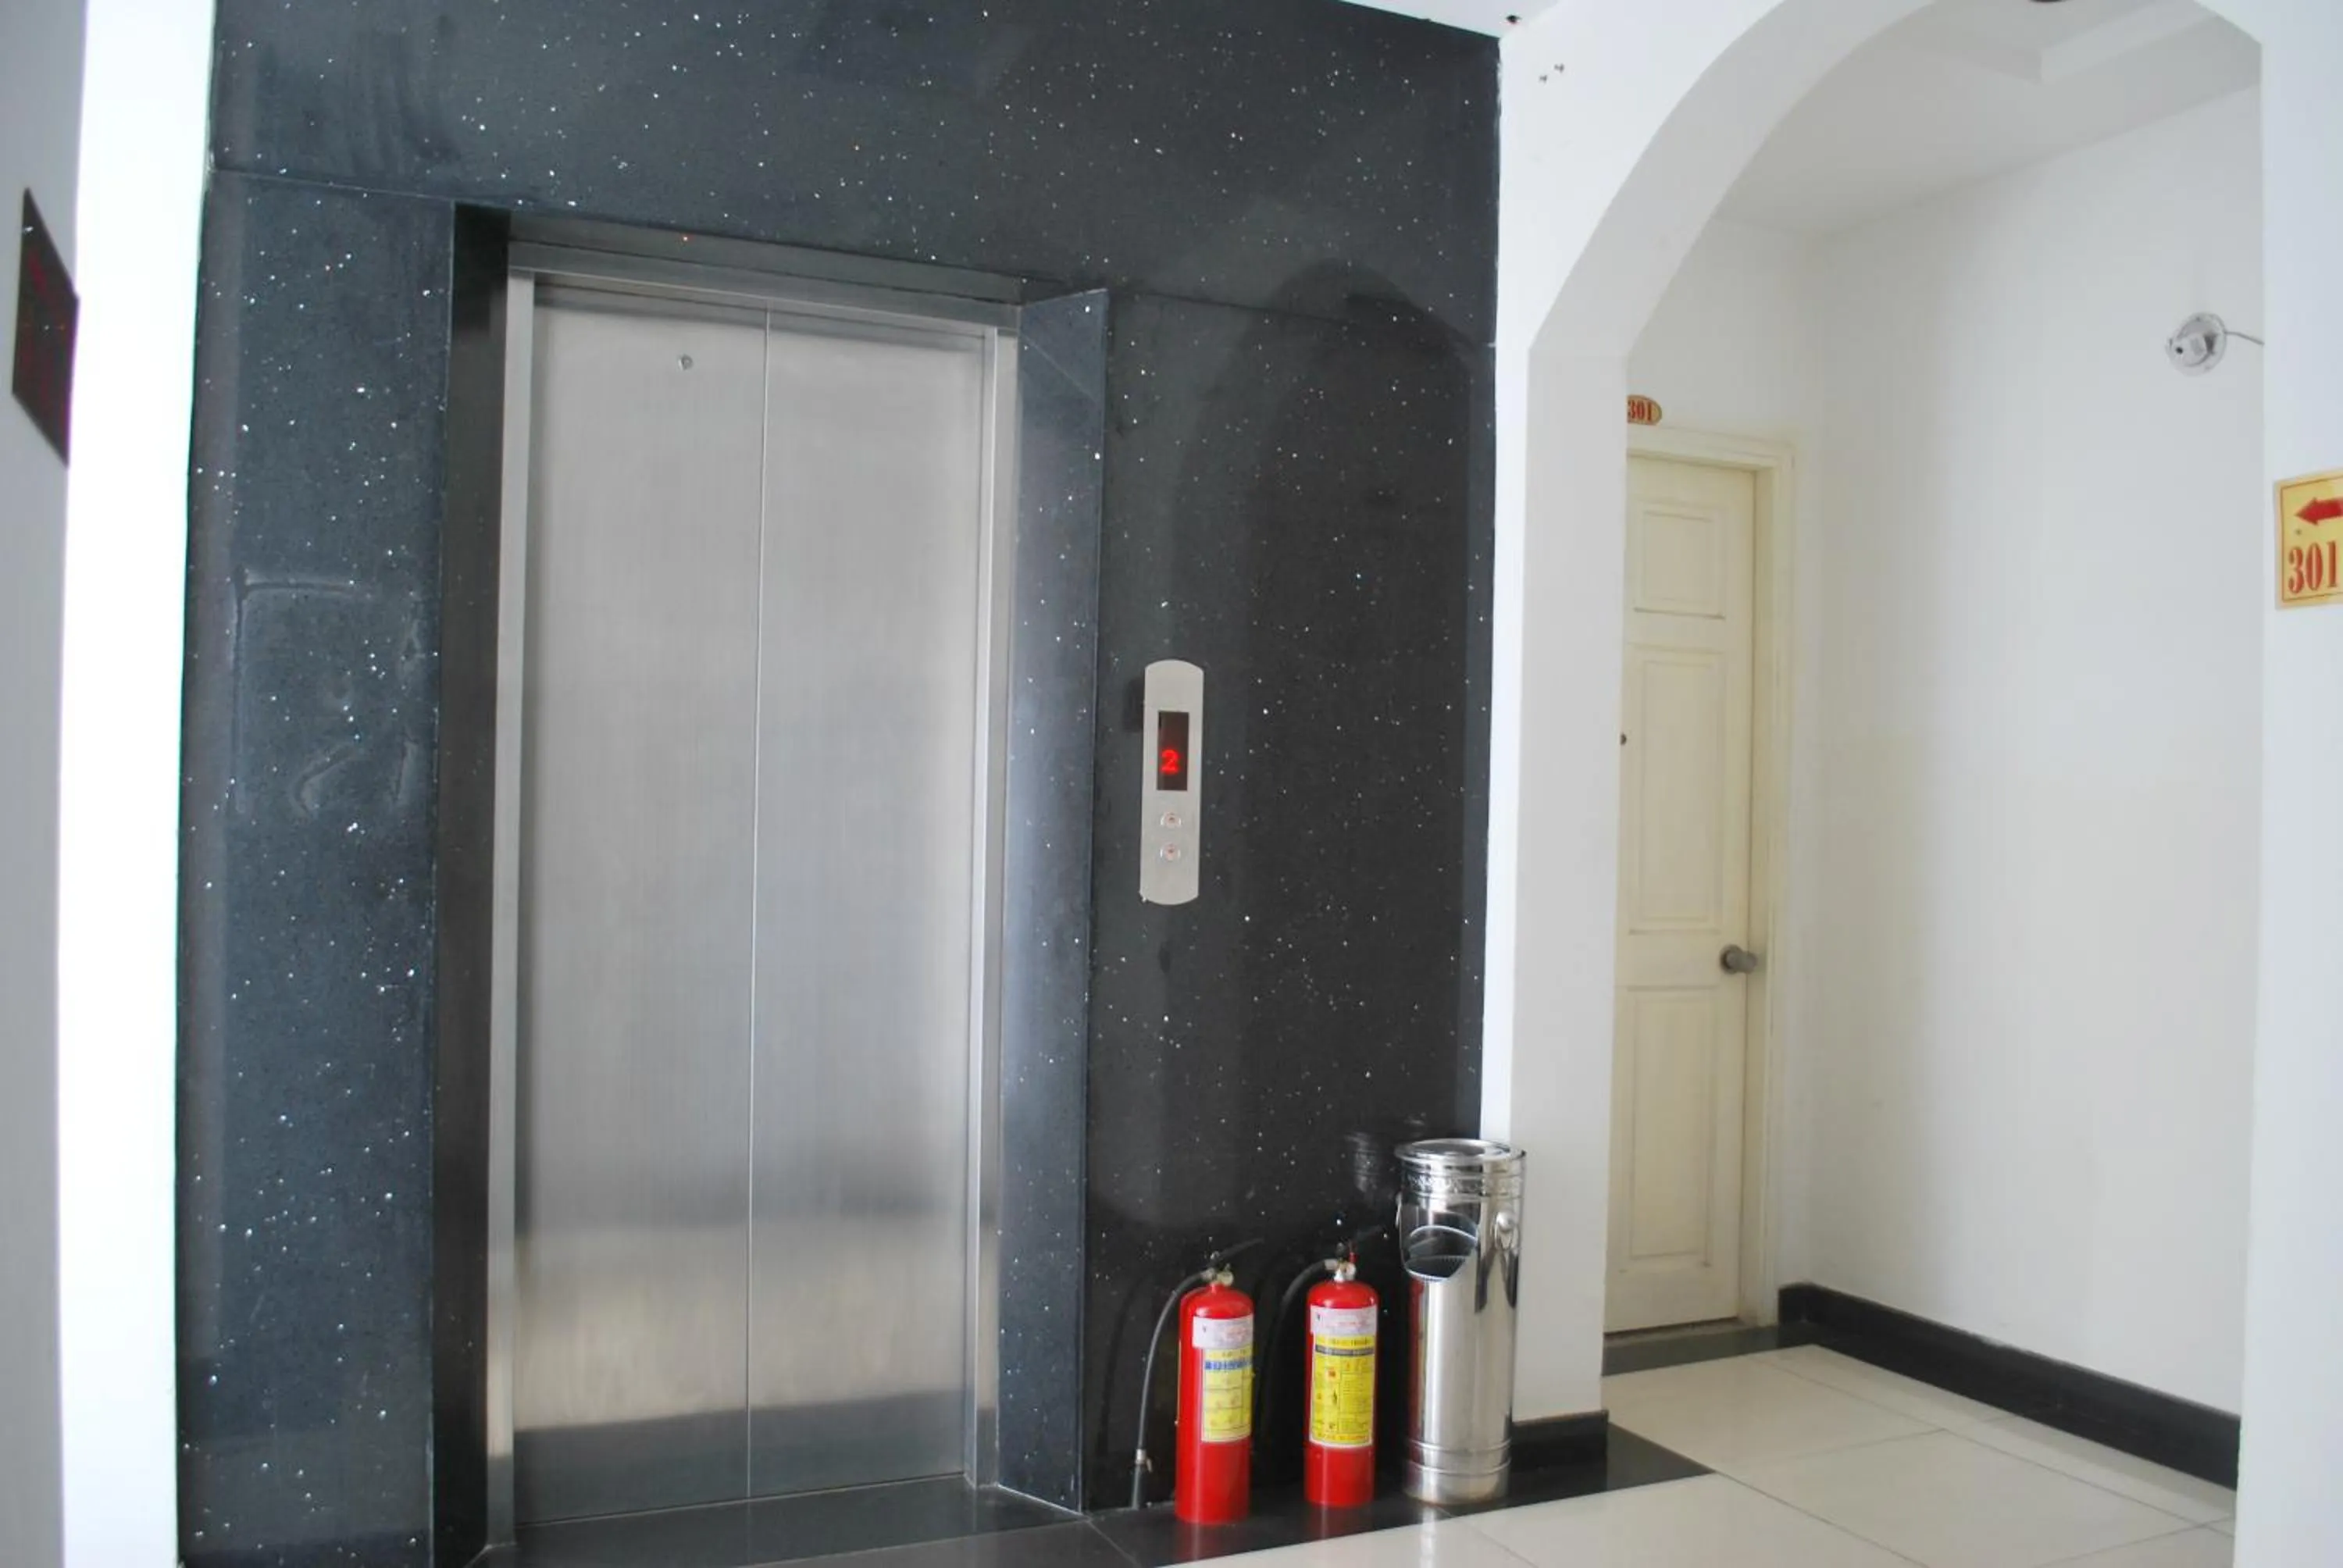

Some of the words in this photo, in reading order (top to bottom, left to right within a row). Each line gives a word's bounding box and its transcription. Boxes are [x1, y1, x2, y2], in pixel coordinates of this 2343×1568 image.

[1627, 399, 1653, 421] 301
[2288, 540, 2337, 594] 301
[1161, 749, 1179, 775] 2
